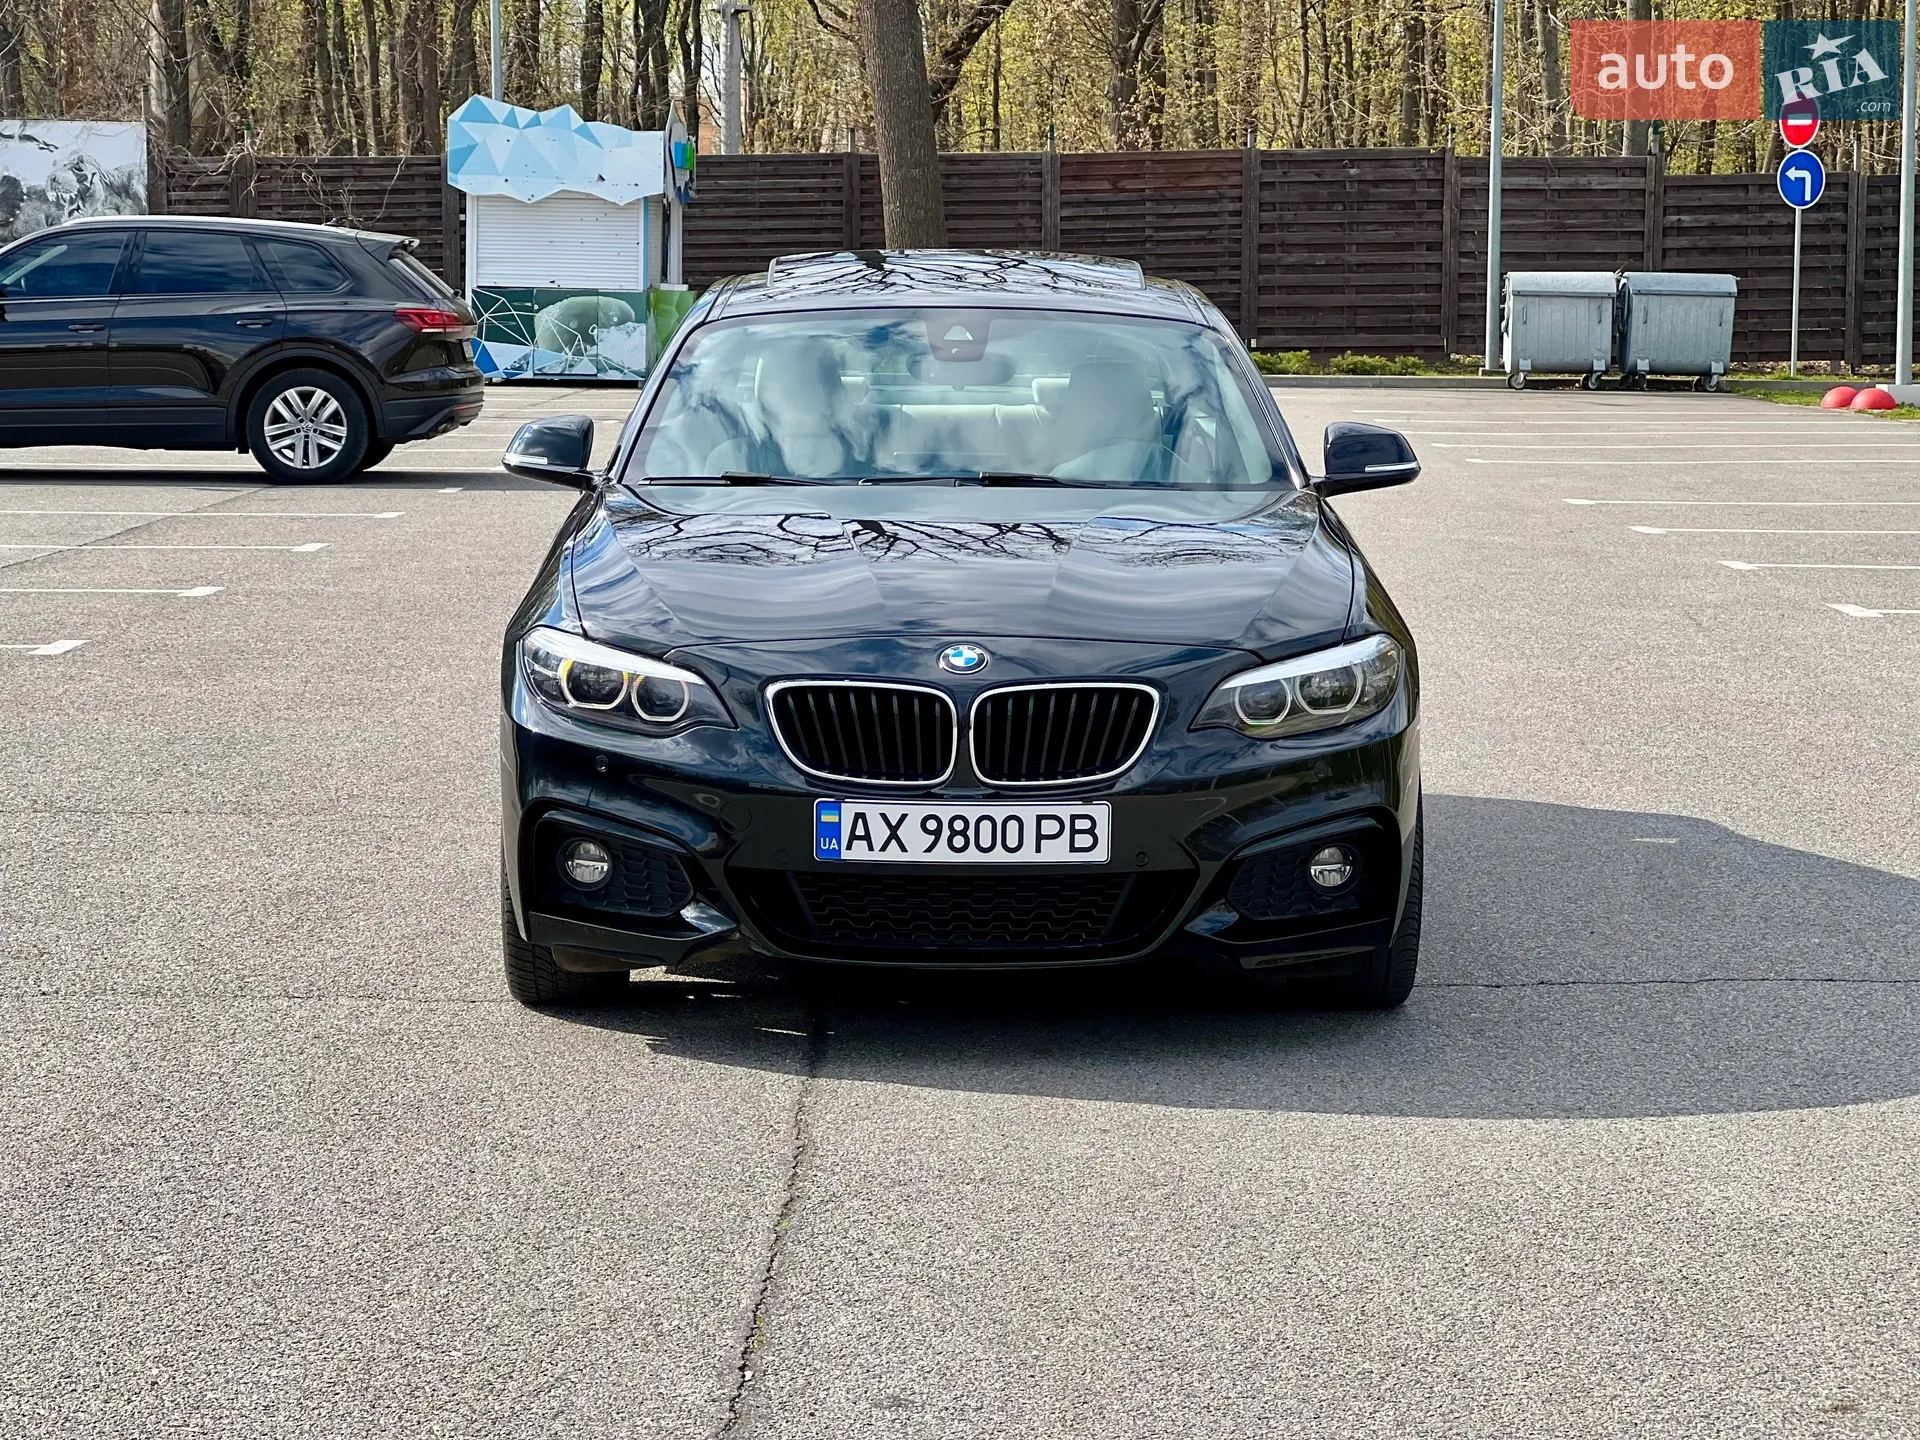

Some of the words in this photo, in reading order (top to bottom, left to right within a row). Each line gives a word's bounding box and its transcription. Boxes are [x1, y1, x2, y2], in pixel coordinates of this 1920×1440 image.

[820, 838, 839, 850] UA
[845, 811, 909, 853] AX
[919, 813, 1025, 854] 9800
[1034, 813, 1099, 854] PB
